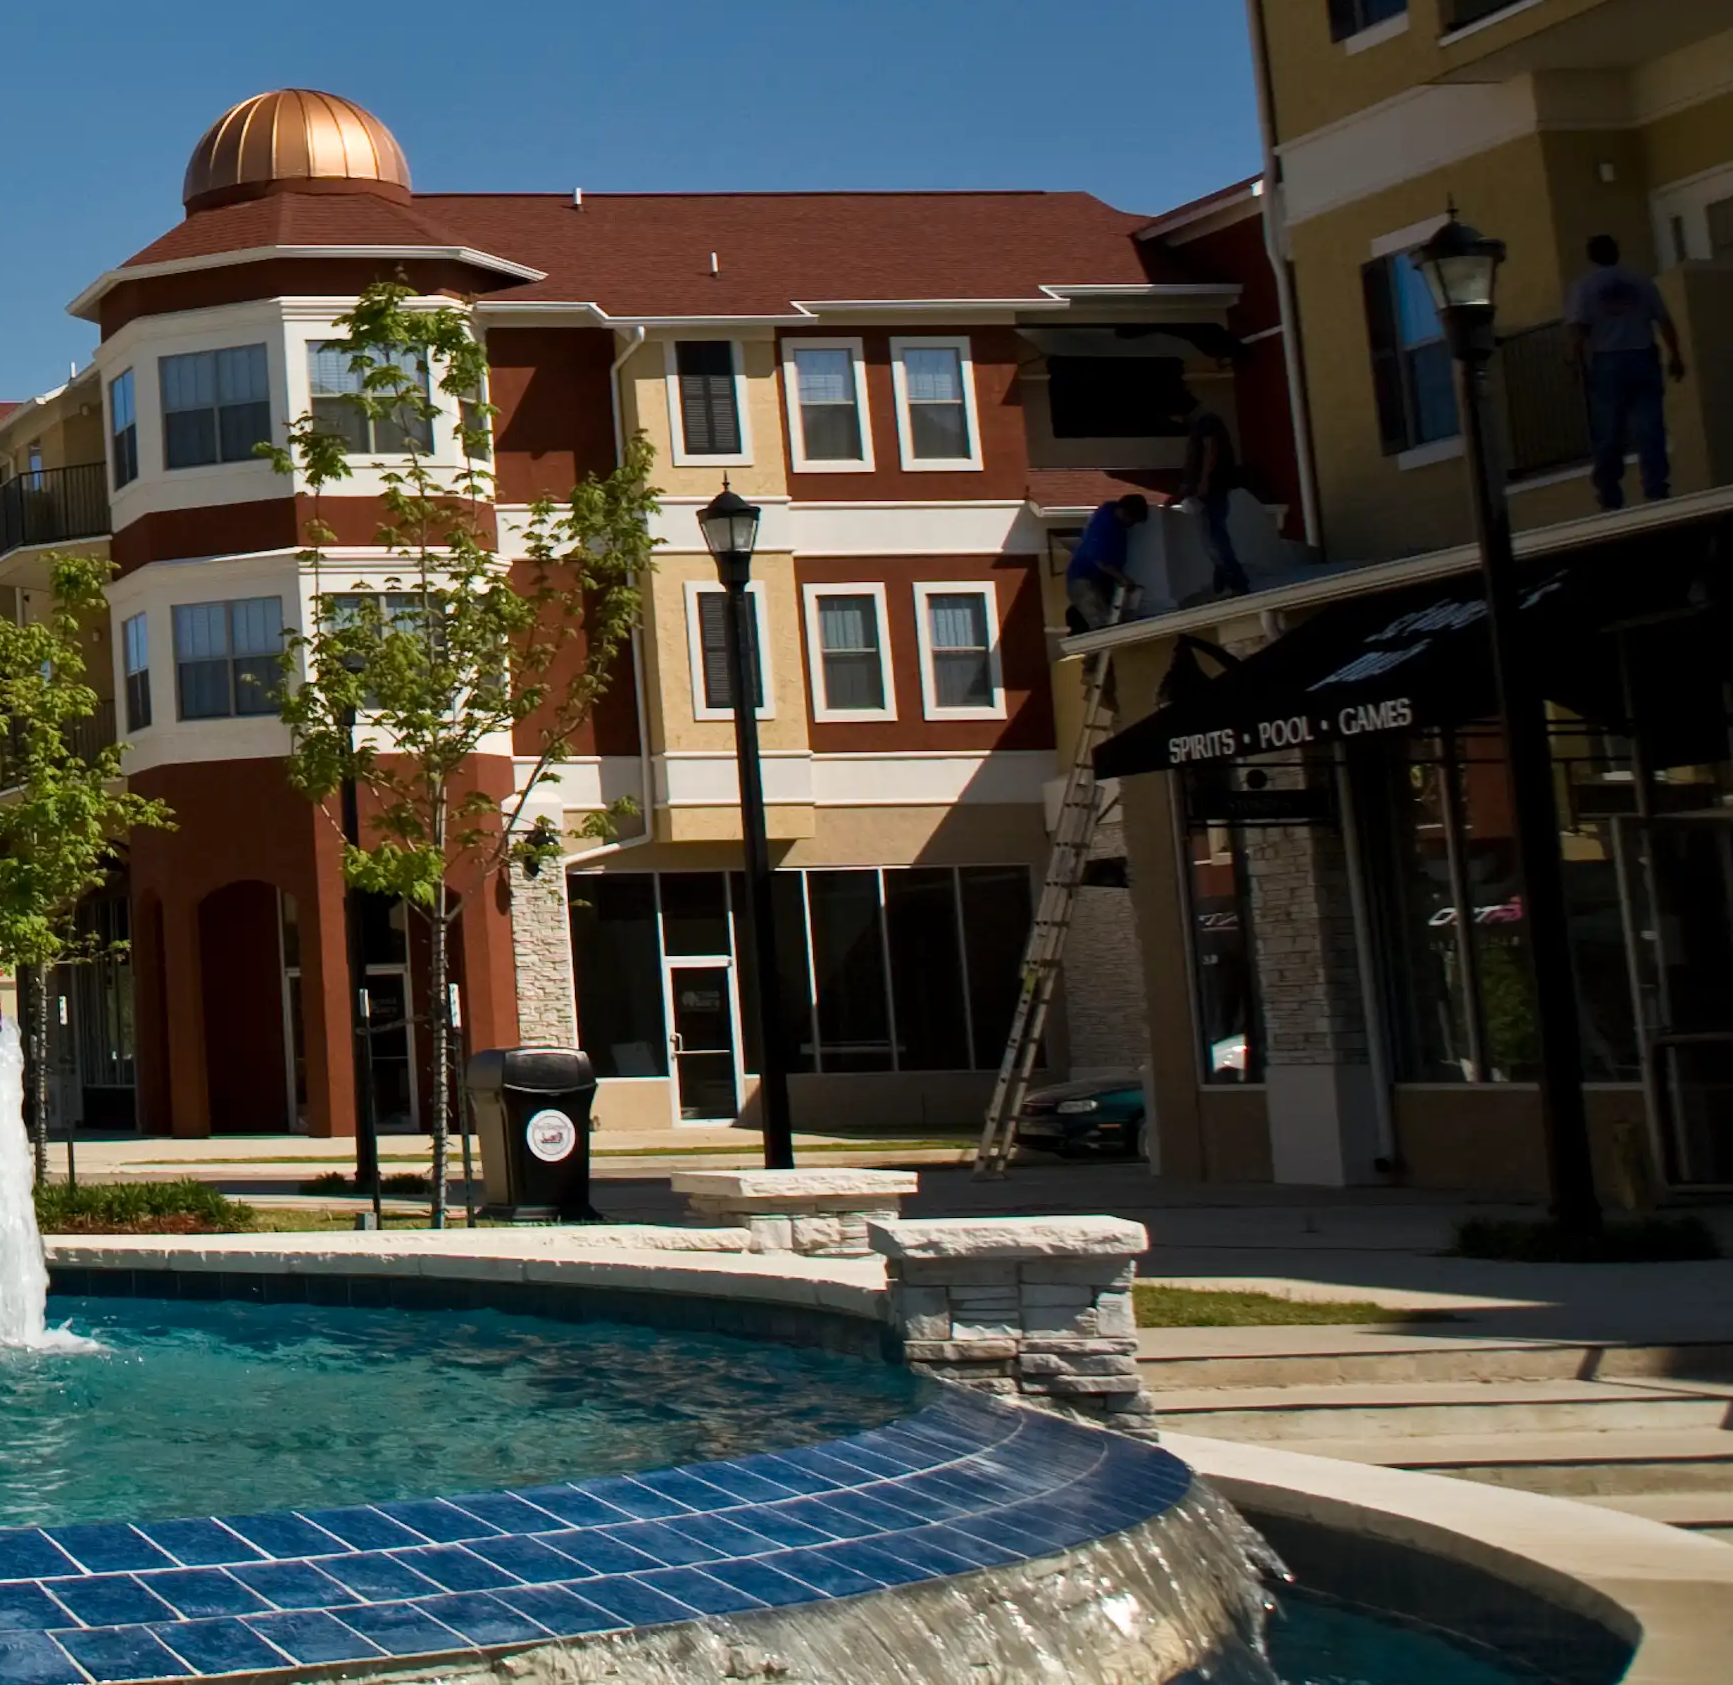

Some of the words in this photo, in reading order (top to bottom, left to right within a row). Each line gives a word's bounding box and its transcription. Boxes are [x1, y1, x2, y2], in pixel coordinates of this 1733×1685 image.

[1168, 727, 1236, 764] SPIRITS
[1257, 715, 1316, 749] POOL
[1337, 696, 1414, 736] GAMES
